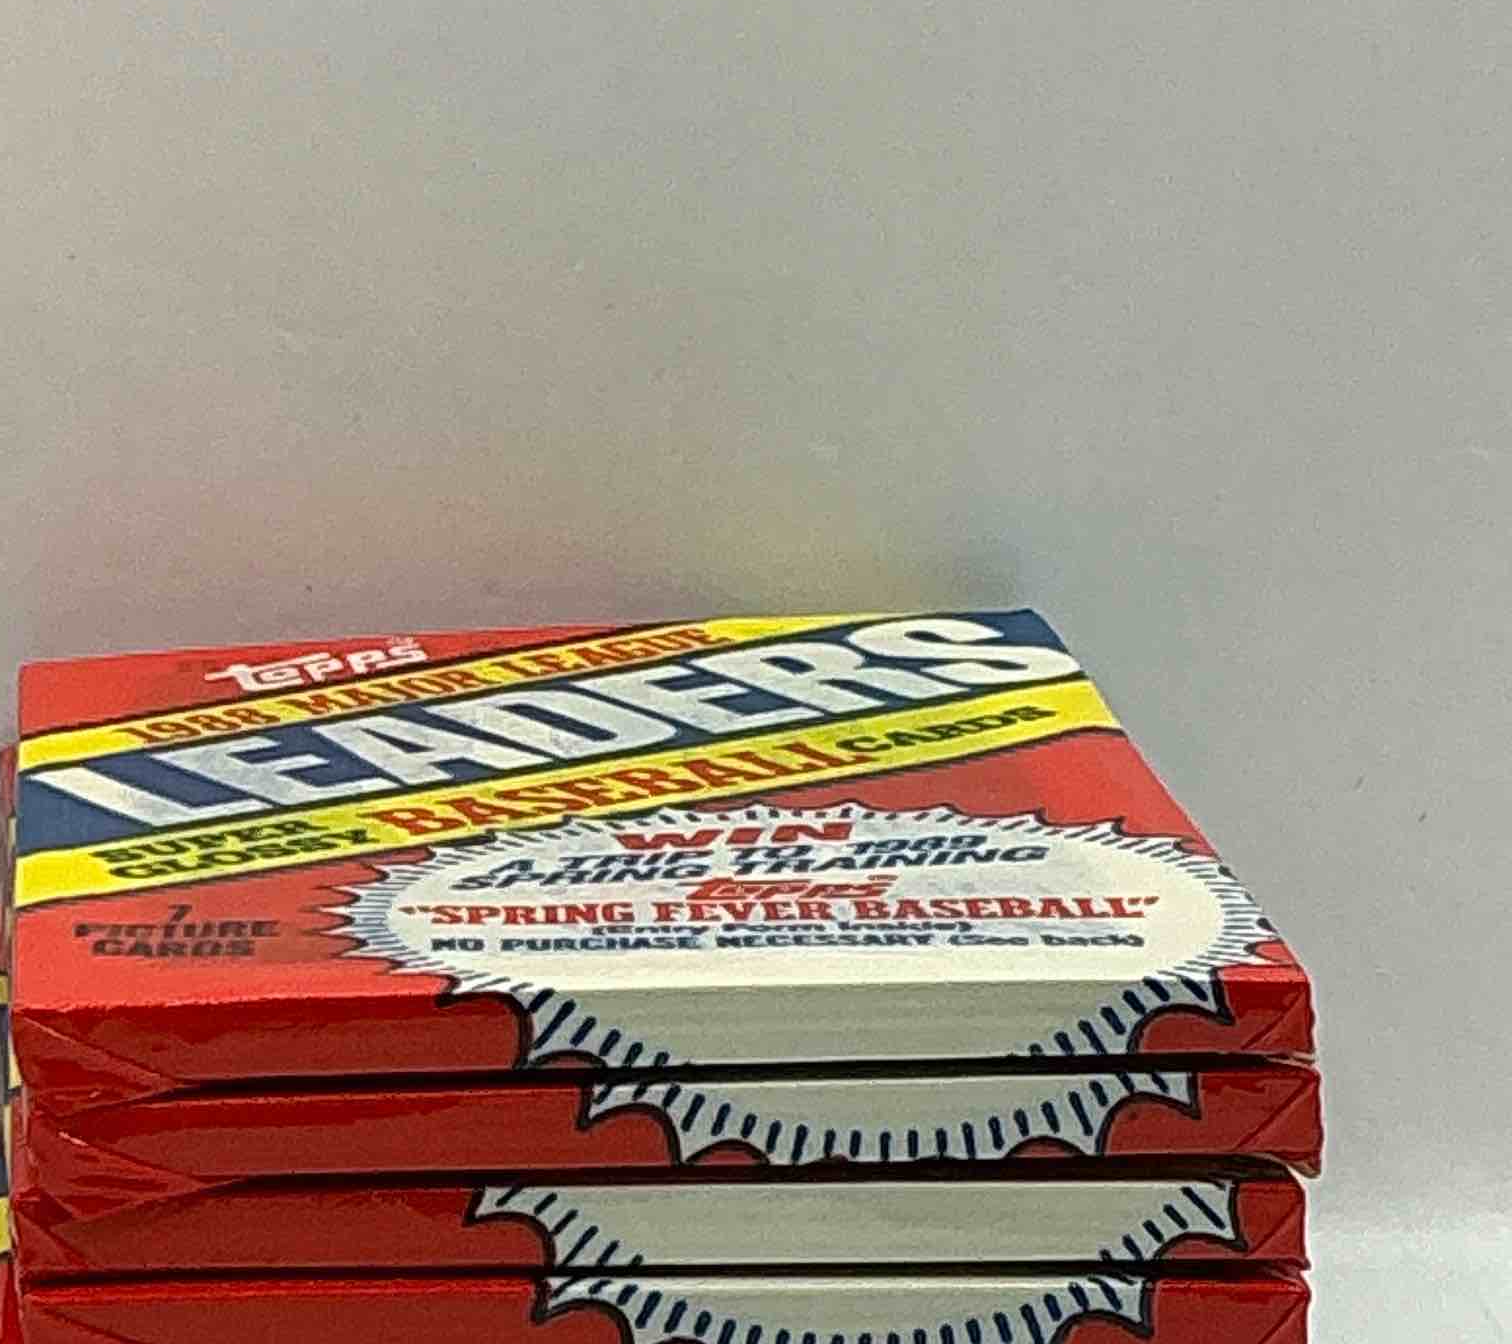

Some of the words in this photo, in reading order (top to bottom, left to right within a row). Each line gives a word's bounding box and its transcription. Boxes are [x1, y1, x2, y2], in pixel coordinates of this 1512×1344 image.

[115, 706, 281, 744] 1988
[283, 669, 490, 714] MAJOR
[487, 629, 731, 682] LEAGUE
[29, 618, 1081, 828] LEADERS
[356, 740, 879, 836] BASEBALL
[835, 705, 1057, 754] CARDS
[89, 819, 330, 863] SUPER
[108, 828, 380, 879] GLOSSY
[613, 822, 853, 850] WIN
[449, 863, 712, 890] SPRING
[731, 845, 1049, 875] TRAINING
[489, 858, 538, 876] A
[731, 845, 813, 862] TO
[167, 904, 194, 922] 7
[651, 899, 834, 922] FEVER
[430, 937, 484, 953] NO
[499, 935, 704, 953] PURCHASE
[715, 932, 937, 949] NECESSARY
